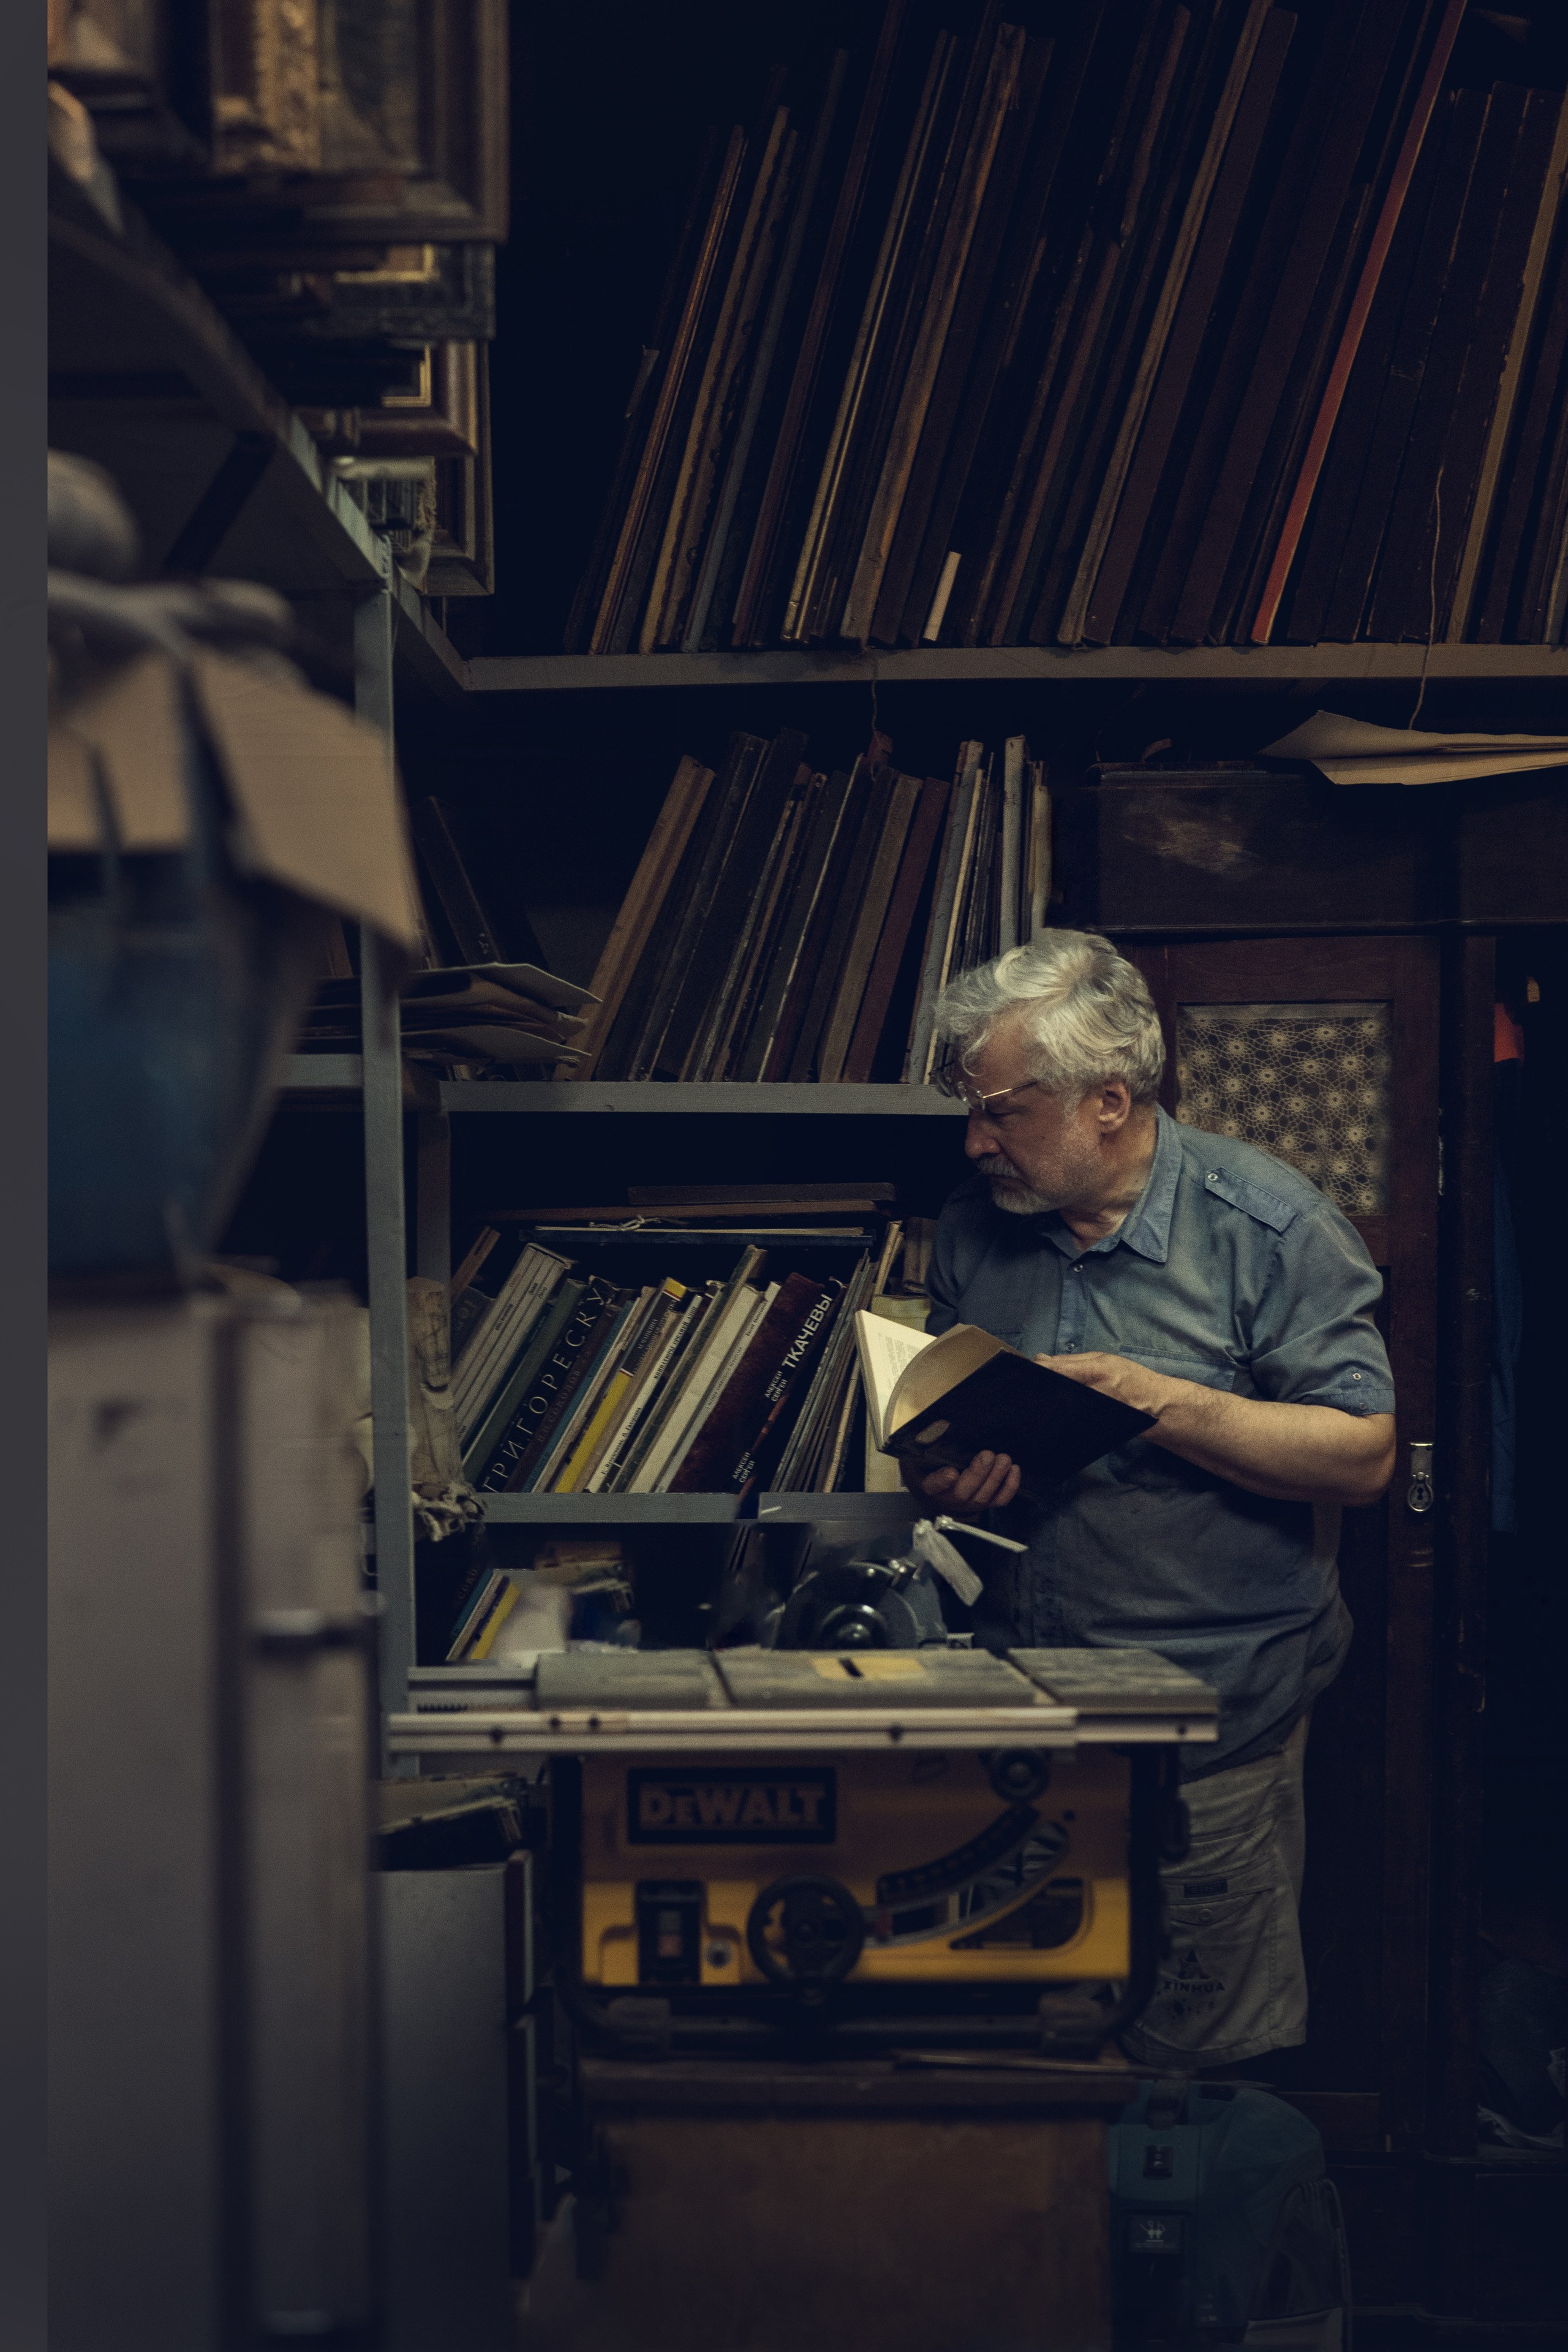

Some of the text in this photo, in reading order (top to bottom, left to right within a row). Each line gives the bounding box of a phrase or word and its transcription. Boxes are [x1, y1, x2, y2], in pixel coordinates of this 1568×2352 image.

[782, 1294, 834, 1368] ТКАЧЕВЫ
[482, 1286, 605, 1494] ГРИГОРЕСКУ
[763, 1370, 783, 1399] АЛЕКСЕЙ
[771, 1378, 788, 1402] СЕРГЕЙ
